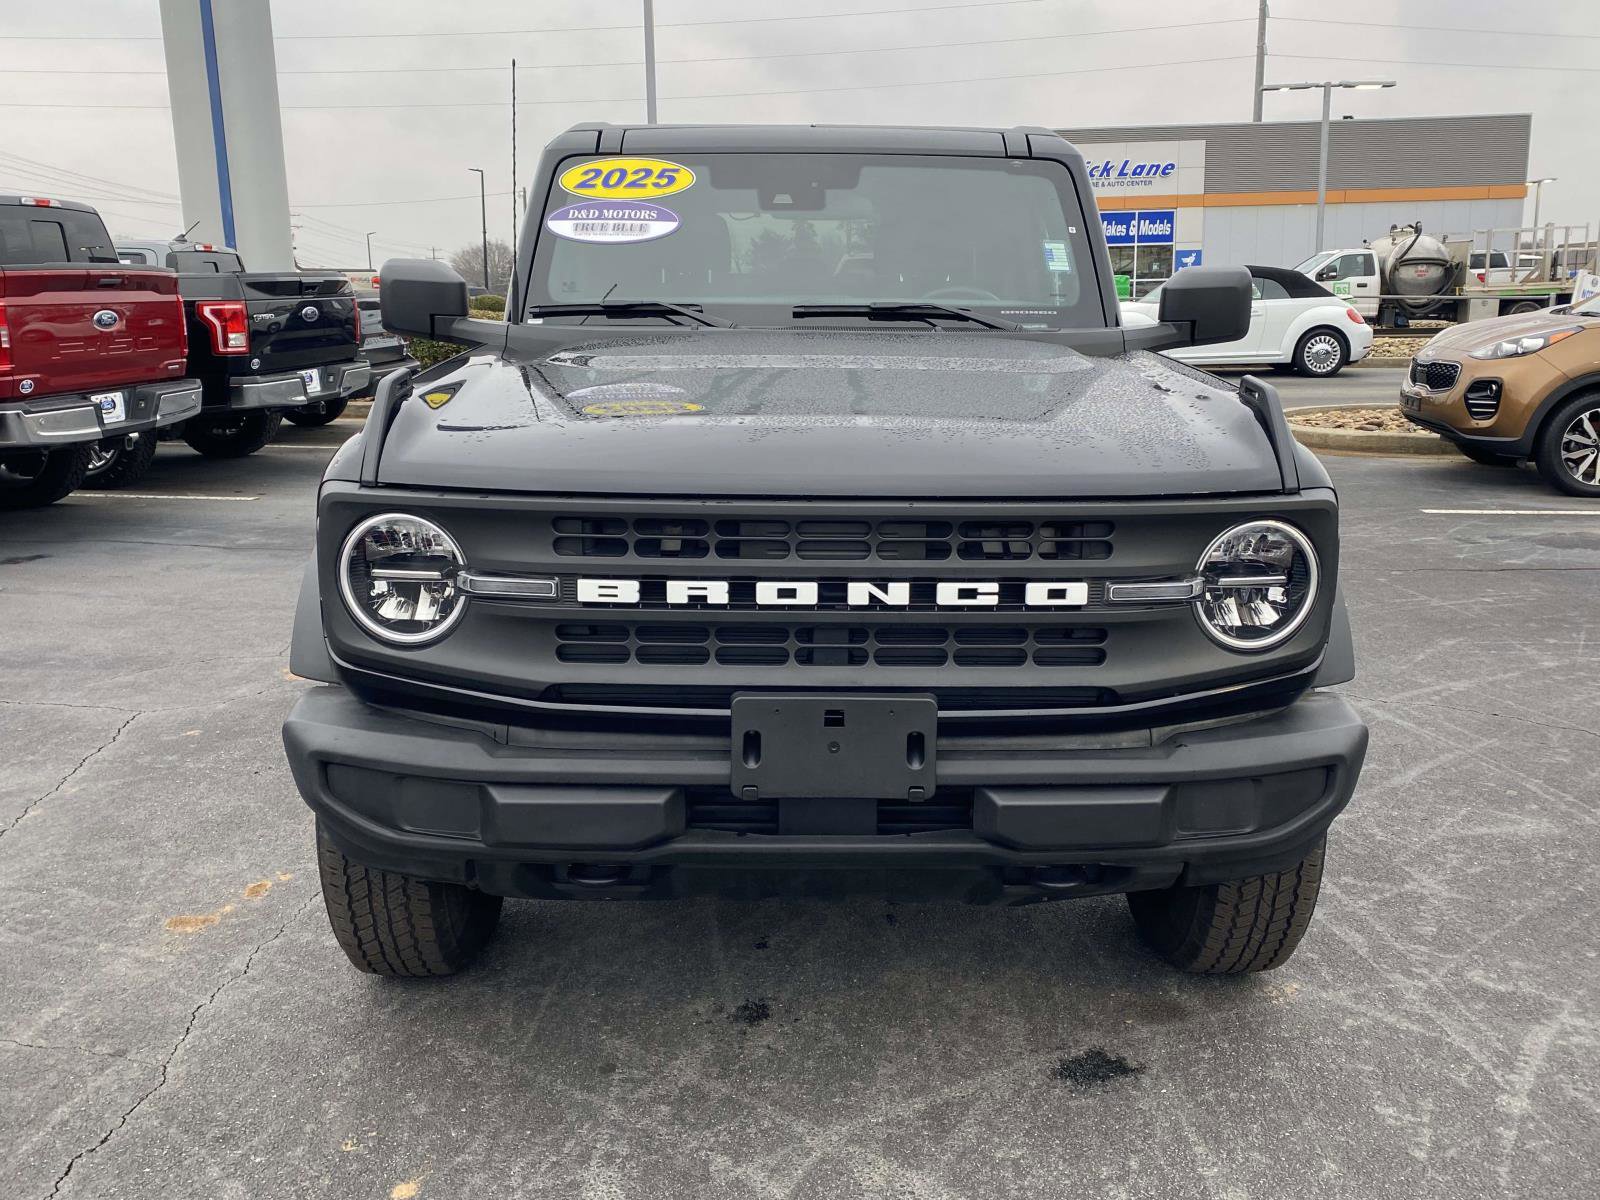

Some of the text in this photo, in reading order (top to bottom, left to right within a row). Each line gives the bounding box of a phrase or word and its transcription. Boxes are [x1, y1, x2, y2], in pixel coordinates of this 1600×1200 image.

[1117, 159, 1176, 178] Lane
[573, 167, 681, 190] 2025
[1106, 180, 1125, 188] AUTO
[1126, 179, 1153, 187] CENTER
[568, 209, 658, 220] D&D MOTORS
[573, 222, 649, 233] TRUE BLUE
[1139, 220, 1171, 236] Models
[576, 578, 1090, 607] BRONCO
